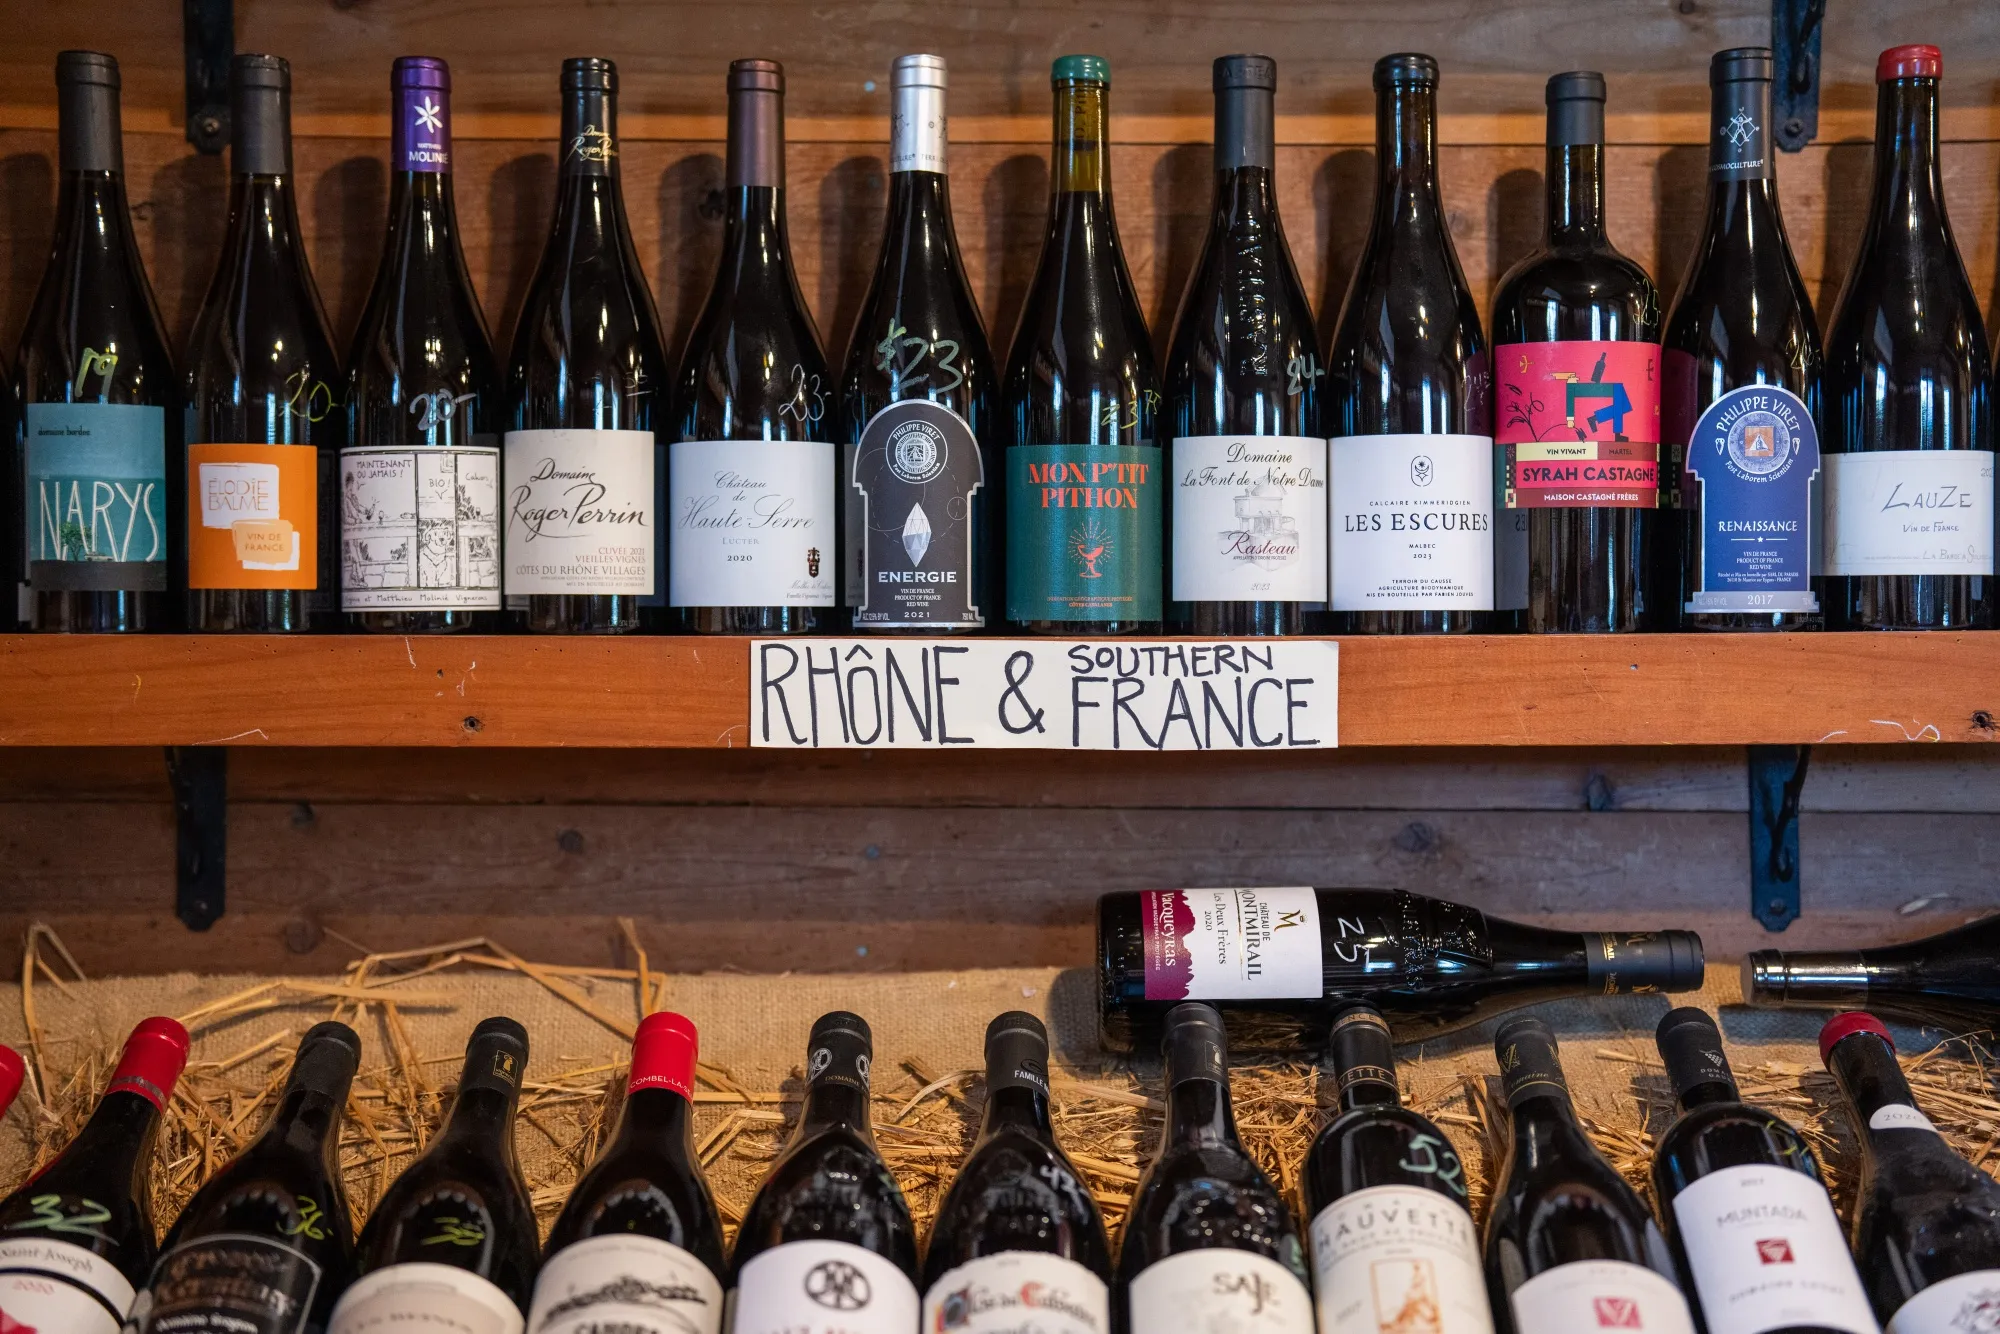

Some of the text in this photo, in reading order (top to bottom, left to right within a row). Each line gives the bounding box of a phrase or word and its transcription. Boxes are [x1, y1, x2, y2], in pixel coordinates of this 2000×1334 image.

[876, 318, 963, 394] $23
[1717, 396, 1801, 432] PHILIPPE VIRET
[893, 423, 941, 440] PHILIPPE VIRET
[1227, 442, 1293, 463] Domaine
[356, 459, 412, 469] MAINTENANT
[530, 457, 598, 483] Domaine
[1028, 463, 1087, 484] MON
[1725, 458, 1794, 483] Post Laborem Scientiam
[356, 469, 367, 479] OU
[368, 469, 397, 478] JAMAIS
[714, 470, 768, 489] Château
[1181, 466, 1324, 488] La Font de Notre Dame
[1522, 467, 1578, 482] SYRAH
[208, 477, 269, 495] ÉLODIE
[208, 495, 269, 511] BALME
[732, 490, 747, 502] de
[1041, 487, 1138, 509] PITHON
[1544, 493, 1574, 501] MAISON
[1576, 492, 1616, 501] CASTAGNÉ
[39, 481, 160, 562] NARYS
[507, 483, 649, 543] Roger Perrin
[1345, 513, 1488, 533] LES ESCURES
[1718, 520, 1798, 532] RENAISSANCE
[1933, 521, 1960, 533] FRANCE
[247, 532, 282, 541] VIN DE
[1220, 530, 1296, 555] Rasteau
[244, 542, 285, 552] FRANCE
[575, 555, 646, 563] VIEILLES VIGNES
[516, 563, 646, 575] CÔTES DU RHÔNE VILLAGES
[878, 571, 957, 583] ENERGIE
[1747, 594, 1774, 605] 2017
[759, 643, 1273, 747] RHÔNE & SOUTHERN
[1070, 676, 1321, 749] FRANCE
[1204, 910, 1213, 931] 2020
[1213, 893, 1230, 965] Les Deux Frères
[1259, 902, 1271, 941] CHÂTEAU DE
[1014, 1070, 1044, 1087] FAMILLE
